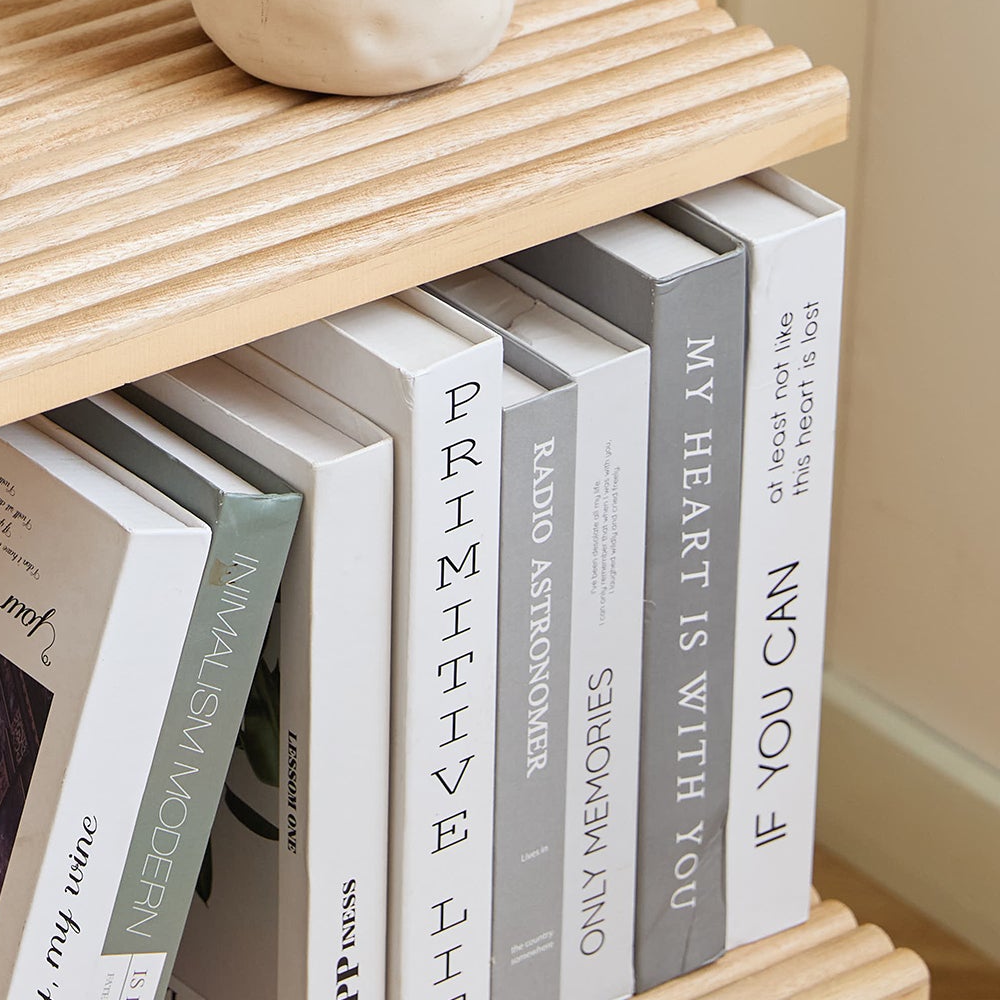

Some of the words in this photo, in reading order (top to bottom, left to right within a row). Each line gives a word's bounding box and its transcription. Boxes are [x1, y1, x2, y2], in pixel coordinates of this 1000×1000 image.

[775, 311, 793, 353] like
[801, 301, 820, 344] lost
[685, 335, 715, 404] MY
[773, 361, 790, 400] not
[798, 351, 816, 370] is
[768, 411, 786, 472] least
[795, 379, 814, 448] heart
[531, 436, 555, 544] RADIO
[680, 428, 712, 588] HEART
[767, 481, 783, 503] at
[792, 454, 811, 496] this
[431, 381, 482, 854] PRIMITIVE
[678, 610, 708, 651] IS
[763, 561, 800, 666] CAN
[527, 558, 553, 779] ASTRONOMER
[287, 729, 298, 811] LESSOM
[583, 667, 614, 856] MEMORIES
[676, 670, 707, 802] WITH
[757, 686, 794, 790] YOU
[126, 761, 200, 938] MODERN
[287, 813, 298, 854] ONE
[520, 849, 541, 863] Lives
[670, 820, 704, 910] YOU
[755, 812, 787, 847] IF
[46, 909, 81, 969] my
[64, 815, 98, 896] wine
[579, 869, 607, 956] ONLY
[130, 970, 148, 989] IS
[430, 898, 468, 1000] LI
